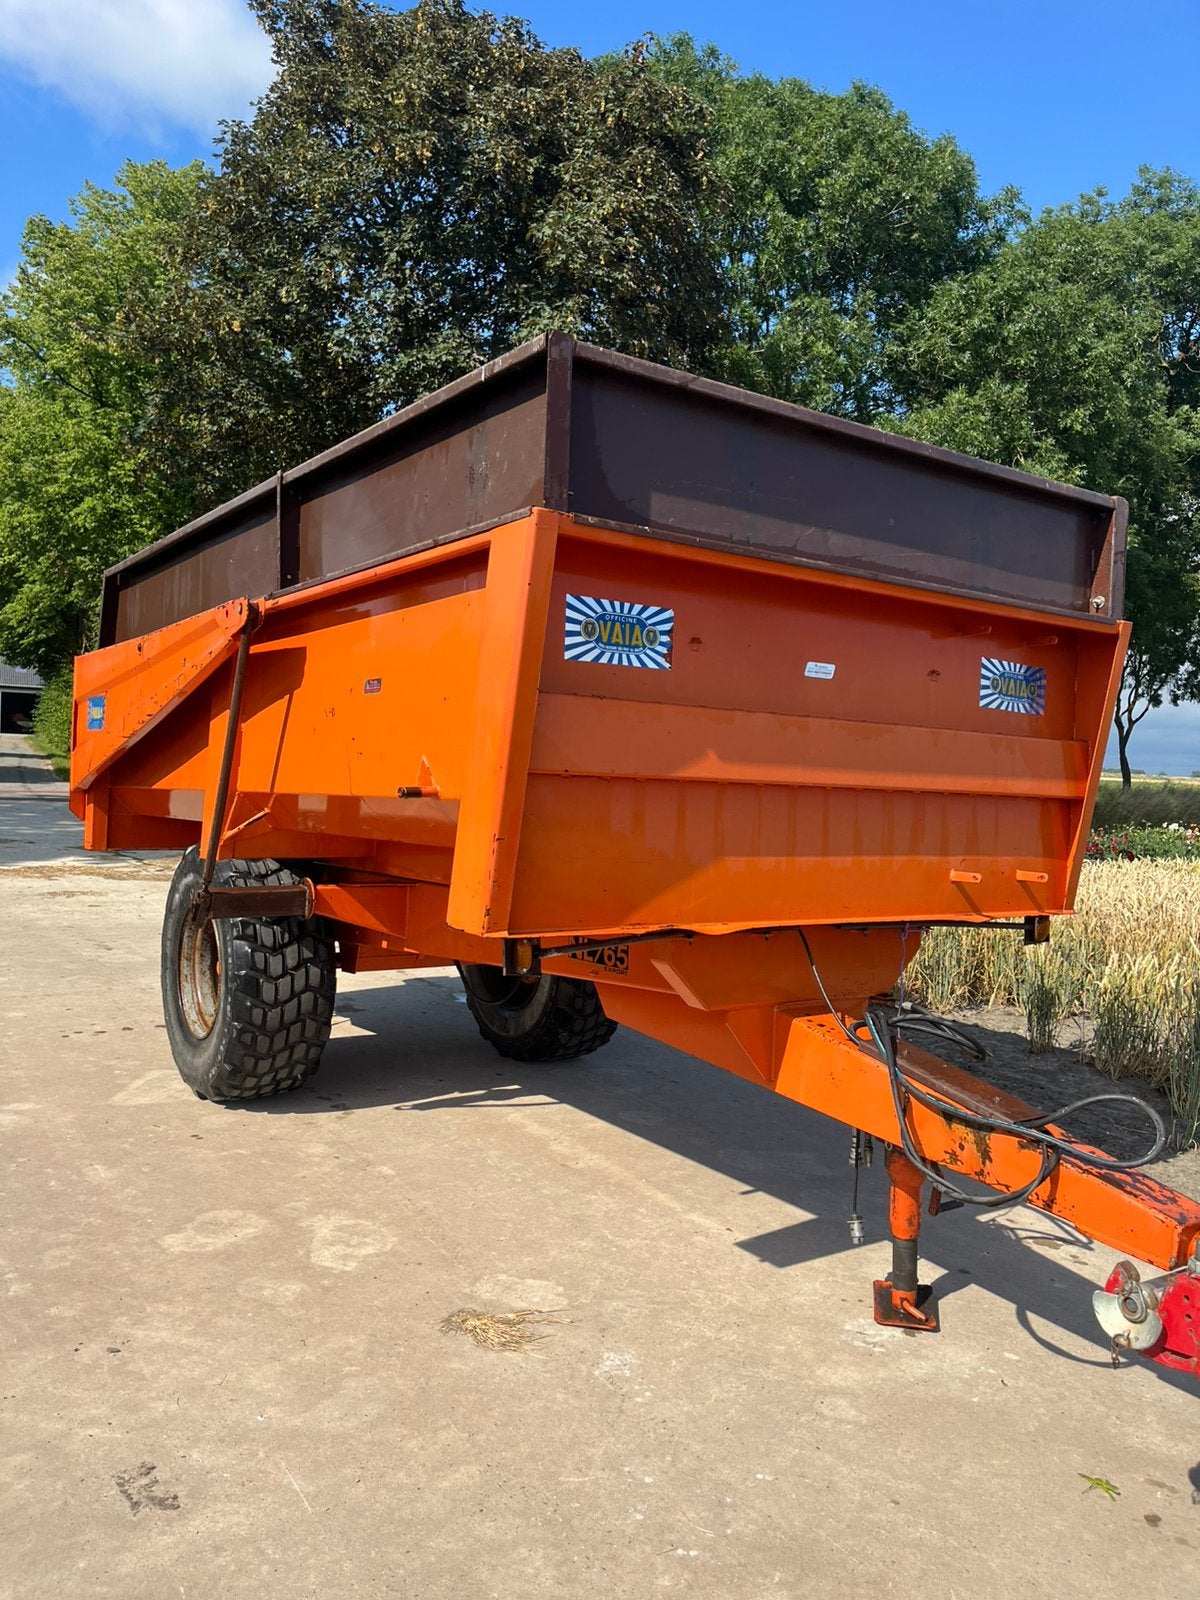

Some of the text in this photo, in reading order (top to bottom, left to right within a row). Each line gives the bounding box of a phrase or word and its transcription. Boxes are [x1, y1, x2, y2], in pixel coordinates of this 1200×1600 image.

[605, 614, 637, 624] OFFICINE
[599, 620, 643, 647] VAIA
[1001, 677, 1027, 697] VAIA
